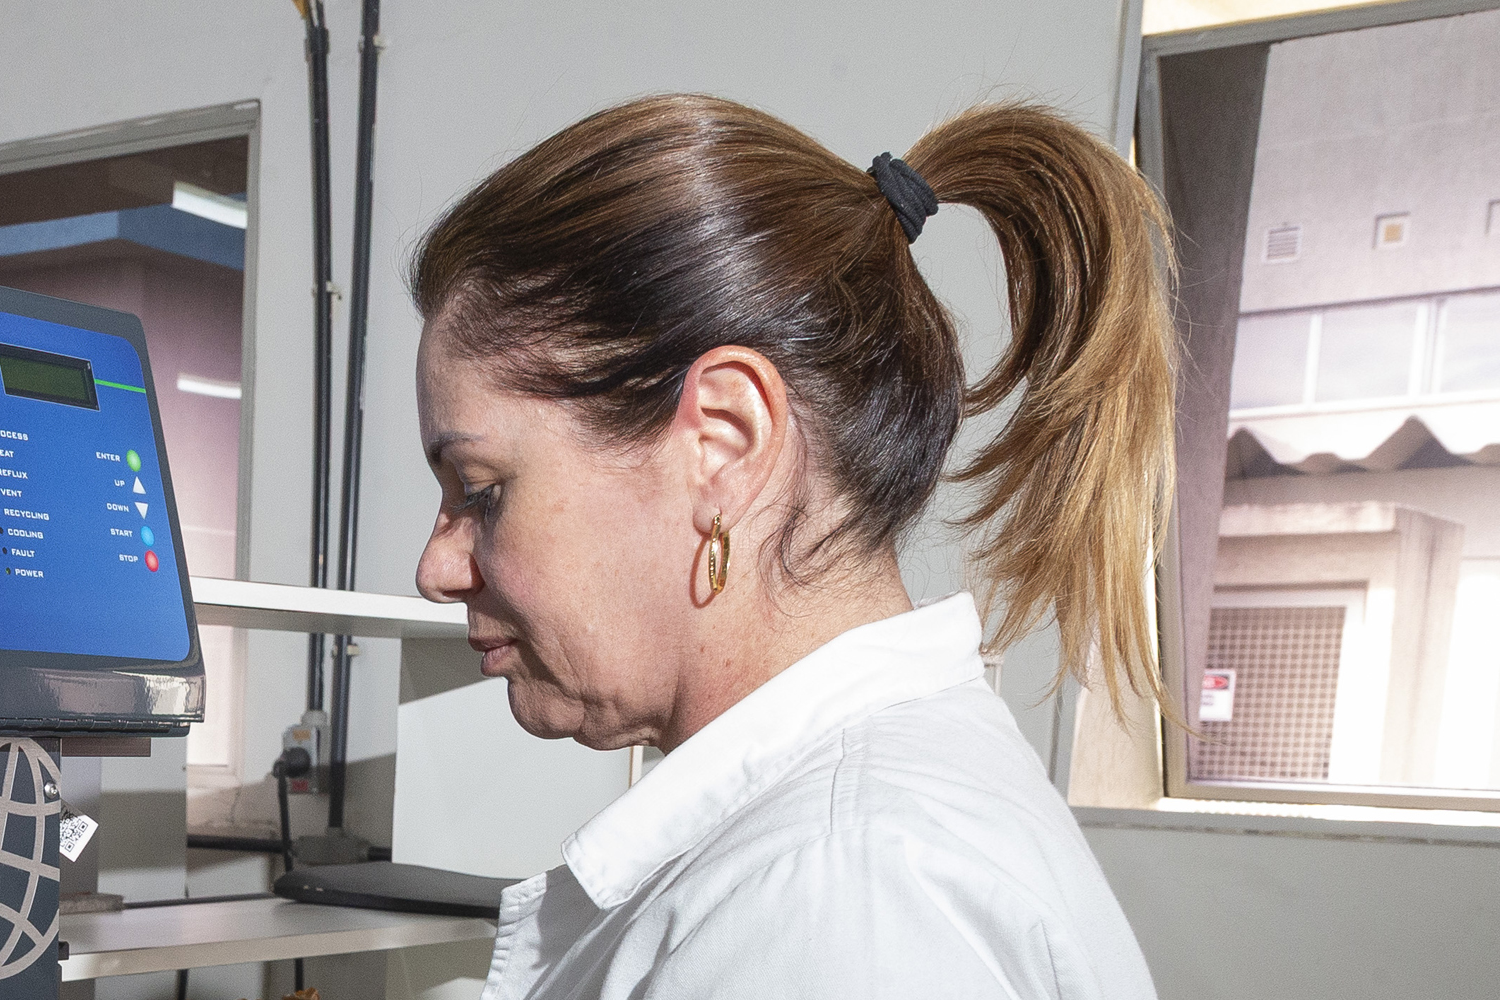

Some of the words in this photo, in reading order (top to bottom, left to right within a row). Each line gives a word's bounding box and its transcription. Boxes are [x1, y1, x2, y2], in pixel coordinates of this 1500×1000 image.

[96, 452, 120, 462] ENTER
[114, 479, 125, 487] UP
[0, 488, 22, 498] VENT
[106, 502, 130, 512] DOWN
[4, 508, 50, 521] RECYCLING
[8, 528, 44, 540] COOLING
[110, 528, 133, 538] START
[11, 548, 35, 558] FAULT
[118, 554, 139, 563] STOP
[14, 568, 44, 578] POWER
